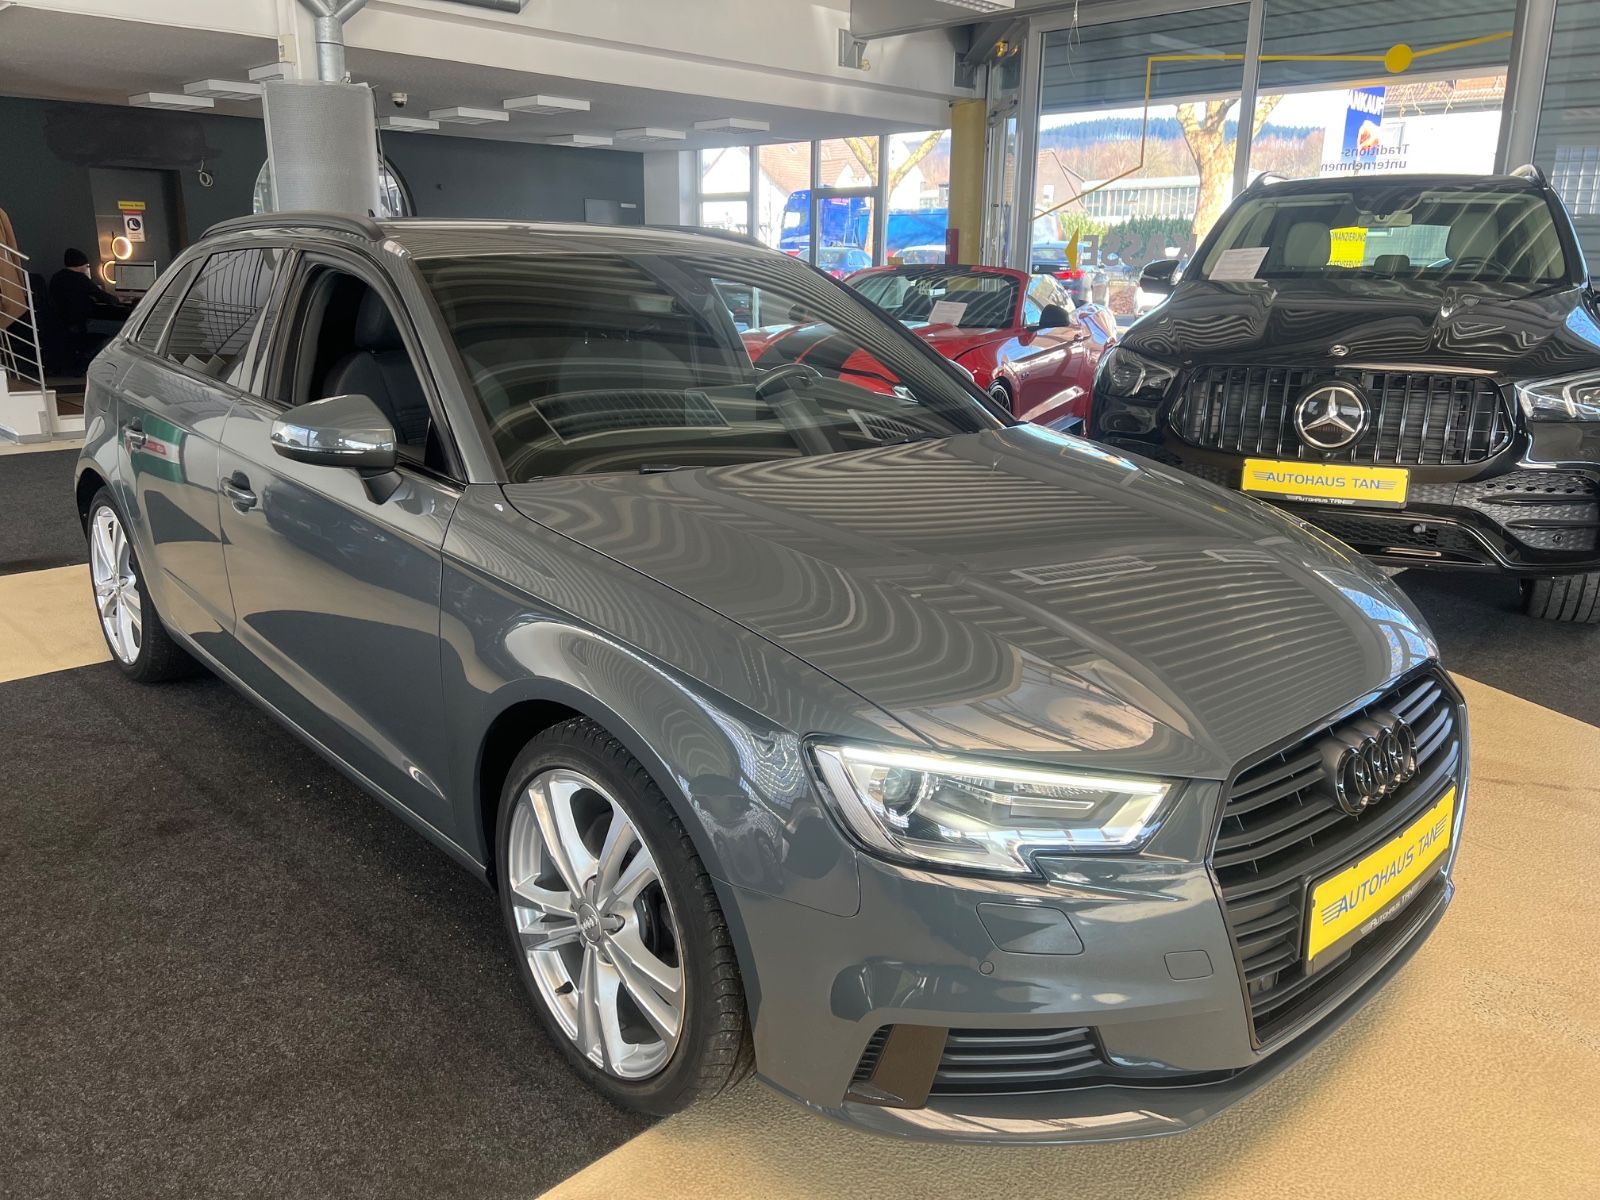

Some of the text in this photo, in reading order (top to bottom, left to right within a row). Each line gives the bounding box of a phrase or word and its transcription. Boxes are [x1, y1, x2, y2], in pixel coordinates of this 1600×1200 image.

[1266, 472, 1381, 490] AUTOHAUS TAN
[1337, 826, 1438, 918] AUTOHAUS TAN
